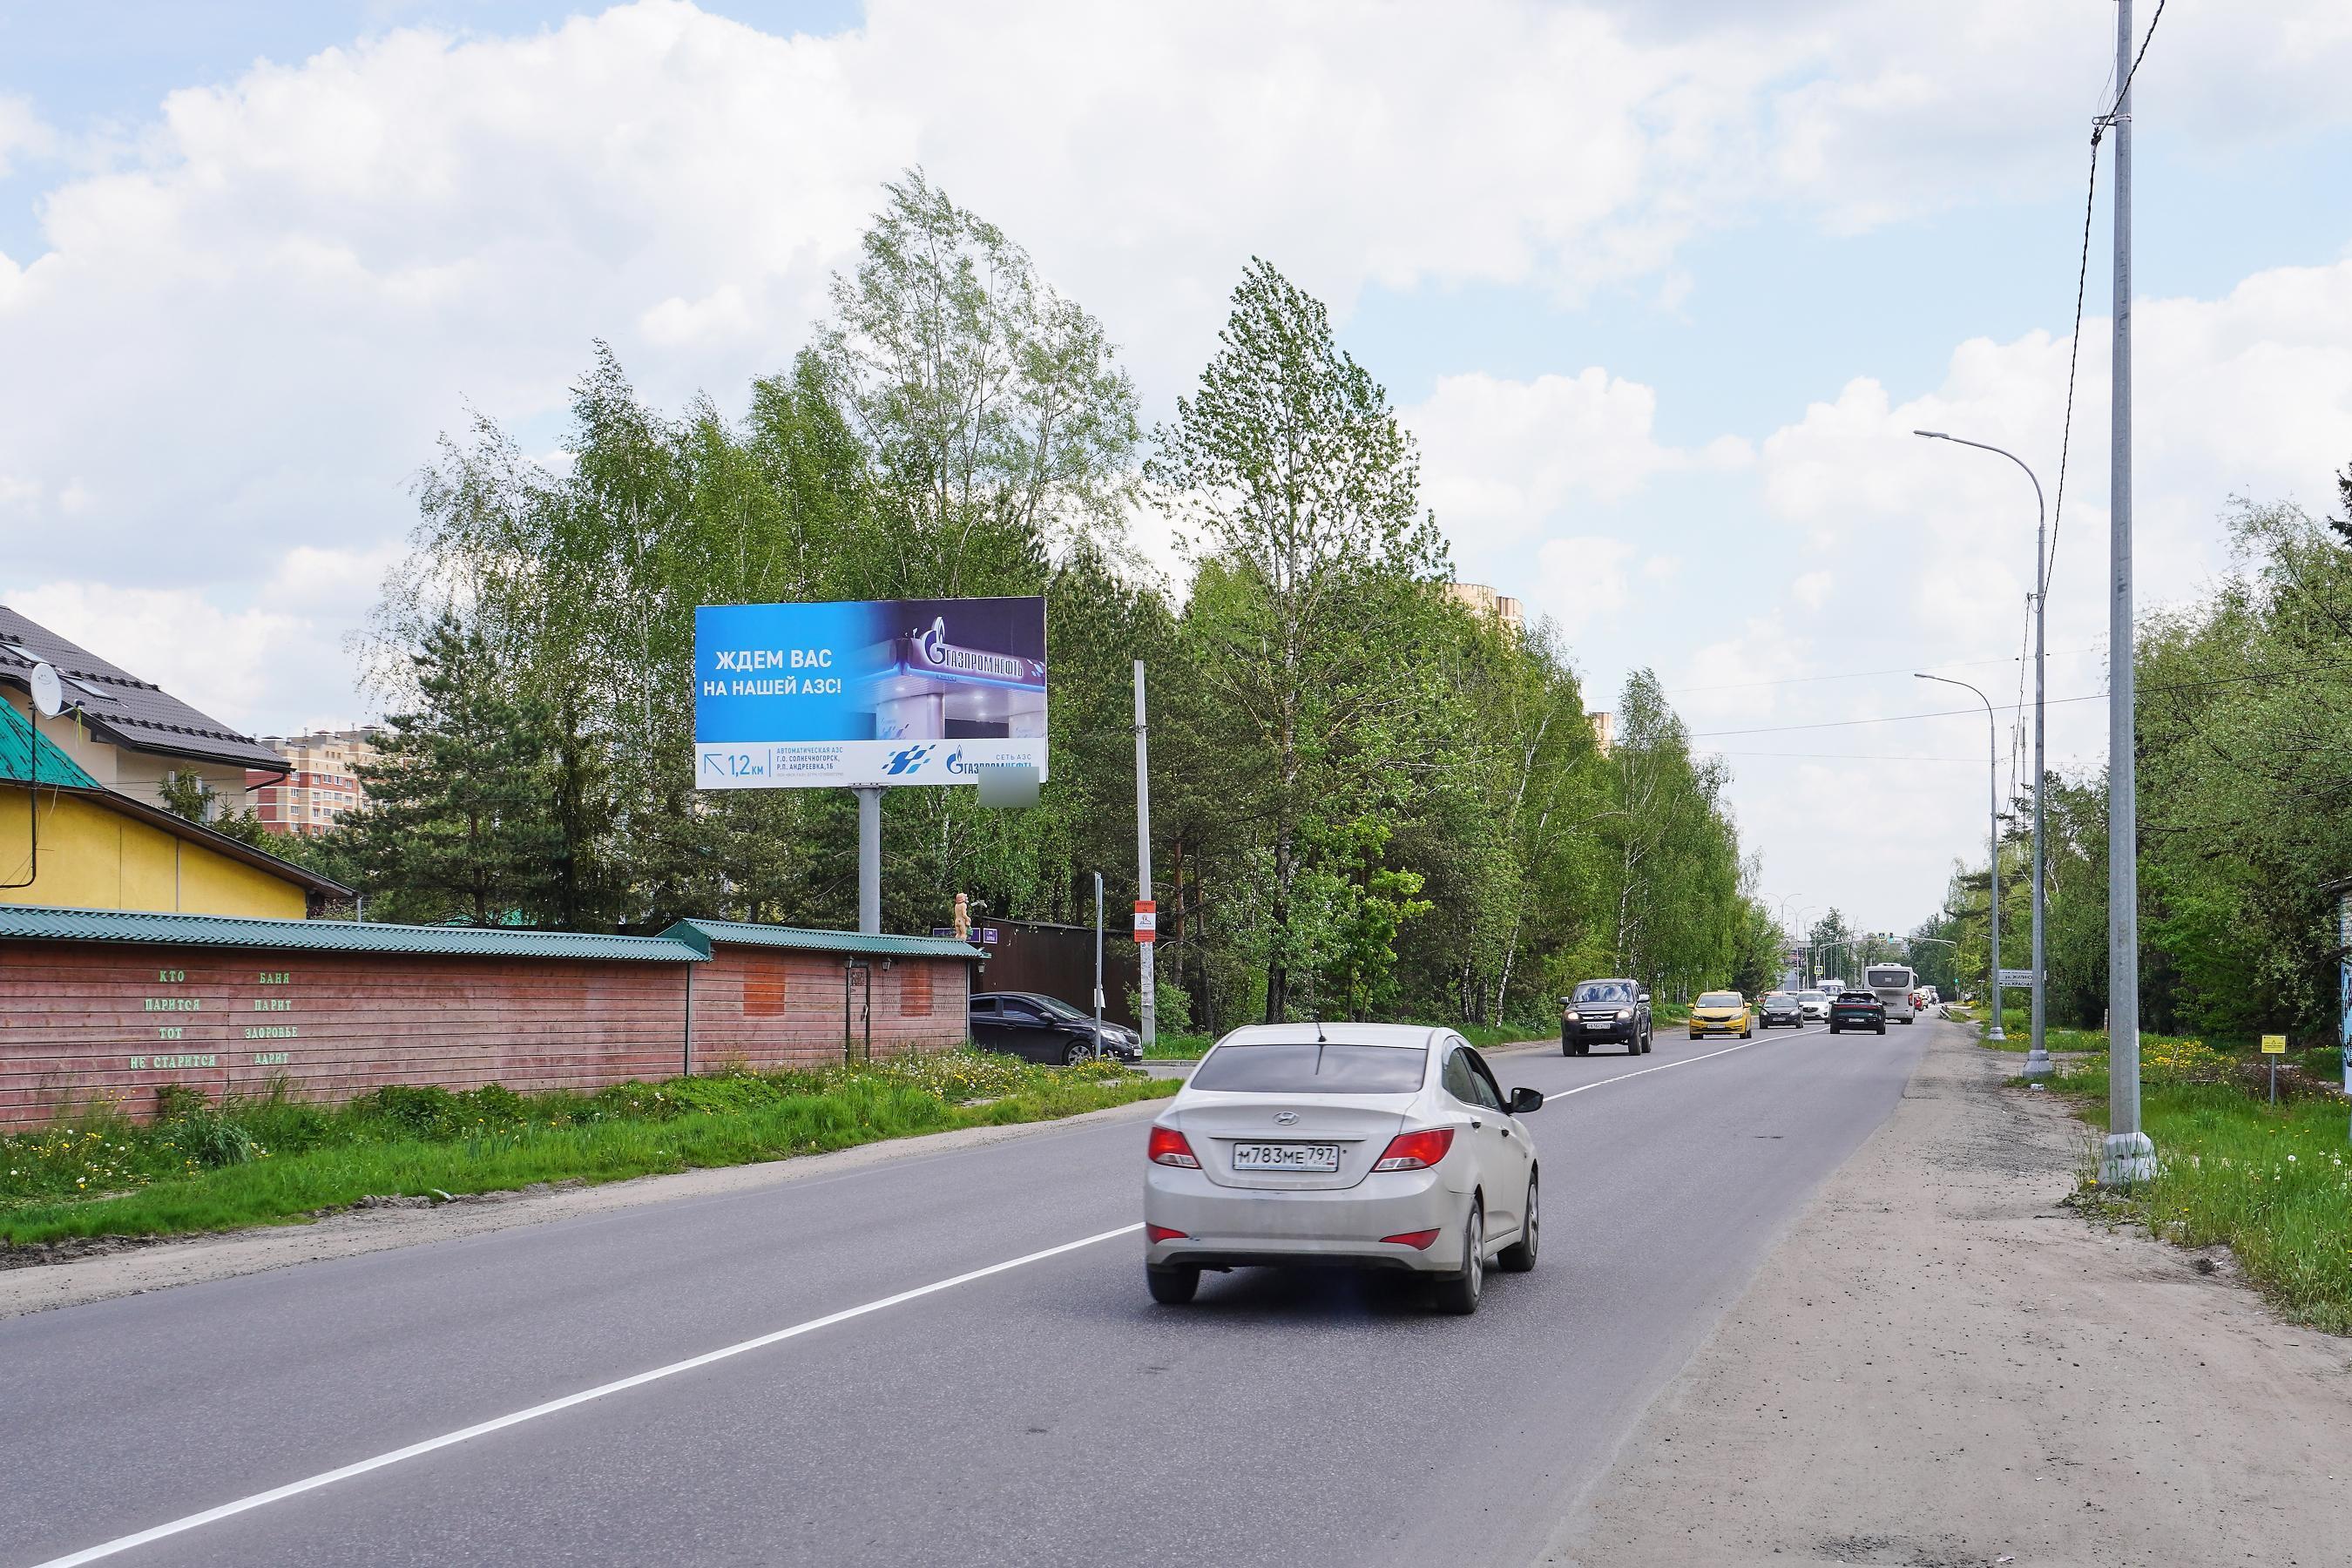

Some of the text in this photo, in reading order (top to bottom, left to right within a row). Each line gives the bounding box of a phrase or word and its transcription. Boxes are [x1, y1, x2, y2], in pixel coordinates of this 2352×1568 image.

[715, 649, 832, 672] ЖДЕМ ВАС
[945, 650, 1023, 677] ГАЗПРОМНЕФТЬ
[704, 676, 841, 696] НА НАШЕЙ АЗС!
[728, 754, 750, 777] 1,2
[159, 970, 186, 983] КТО
[260, 972, 290, 984] БАНЯ
[145, 999, 200, 1011] ПАРИТСЯ
[254, 1000, 291, 1011] ПАРИТ
[159, 1028, 182, 1039] ТОТ
[245, 1027, 298, 1038] ЗДОРОВЬЕ
[130, 1056, 215, 1069] НЕ СТАРИТСЯ
[254, 1054, 290, 1064] ДАРИТ
